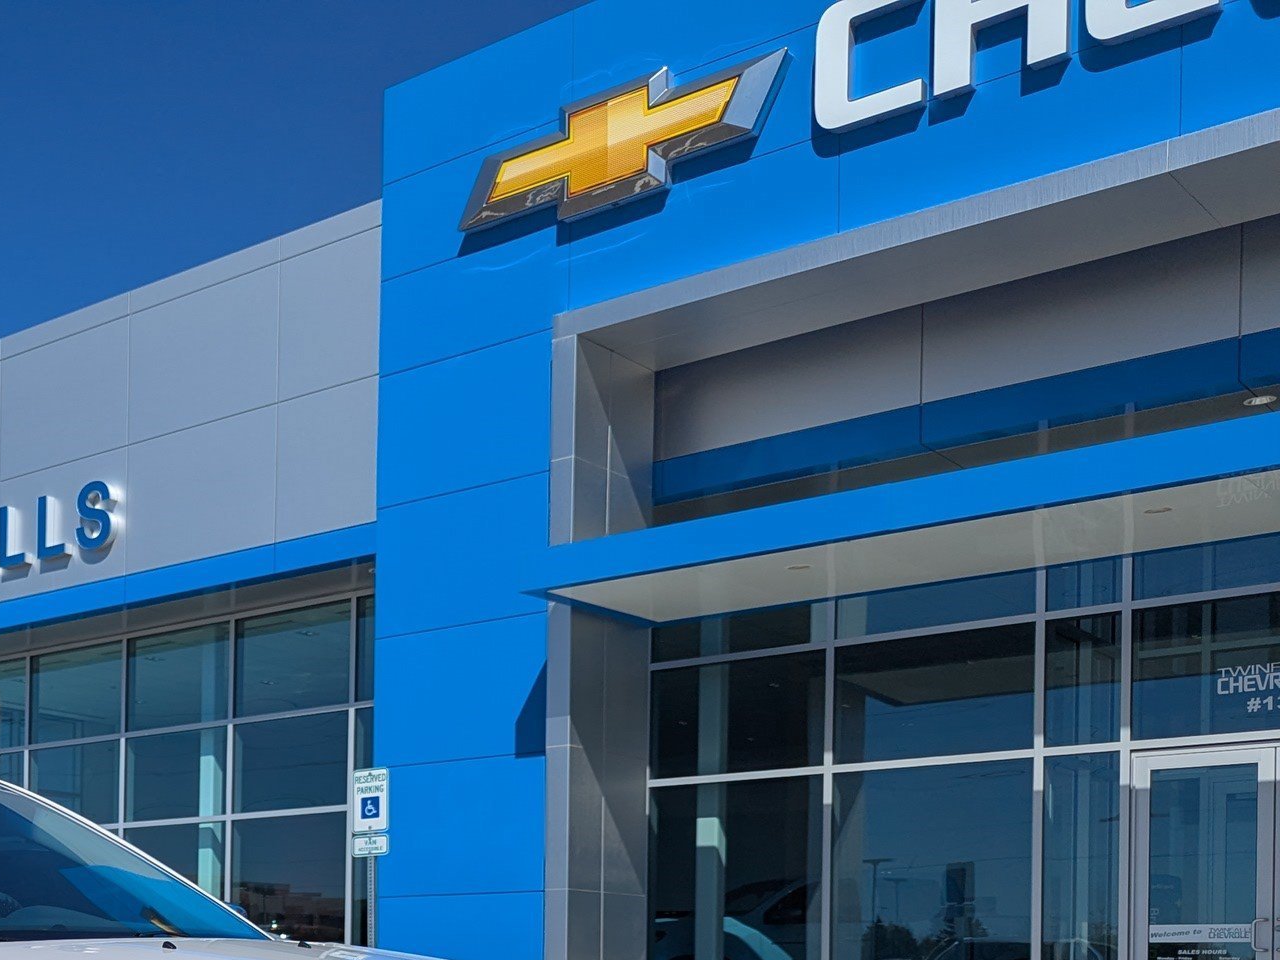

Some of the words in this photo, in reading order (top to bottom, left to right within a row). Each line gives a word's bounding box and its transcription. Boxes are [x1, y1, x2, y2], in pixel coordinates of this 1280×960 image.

[355, 773, 386, 785] RESERVED
[356, 784, 384, 795] PARKING
[1150, 930, 1190, 939] Welcome
